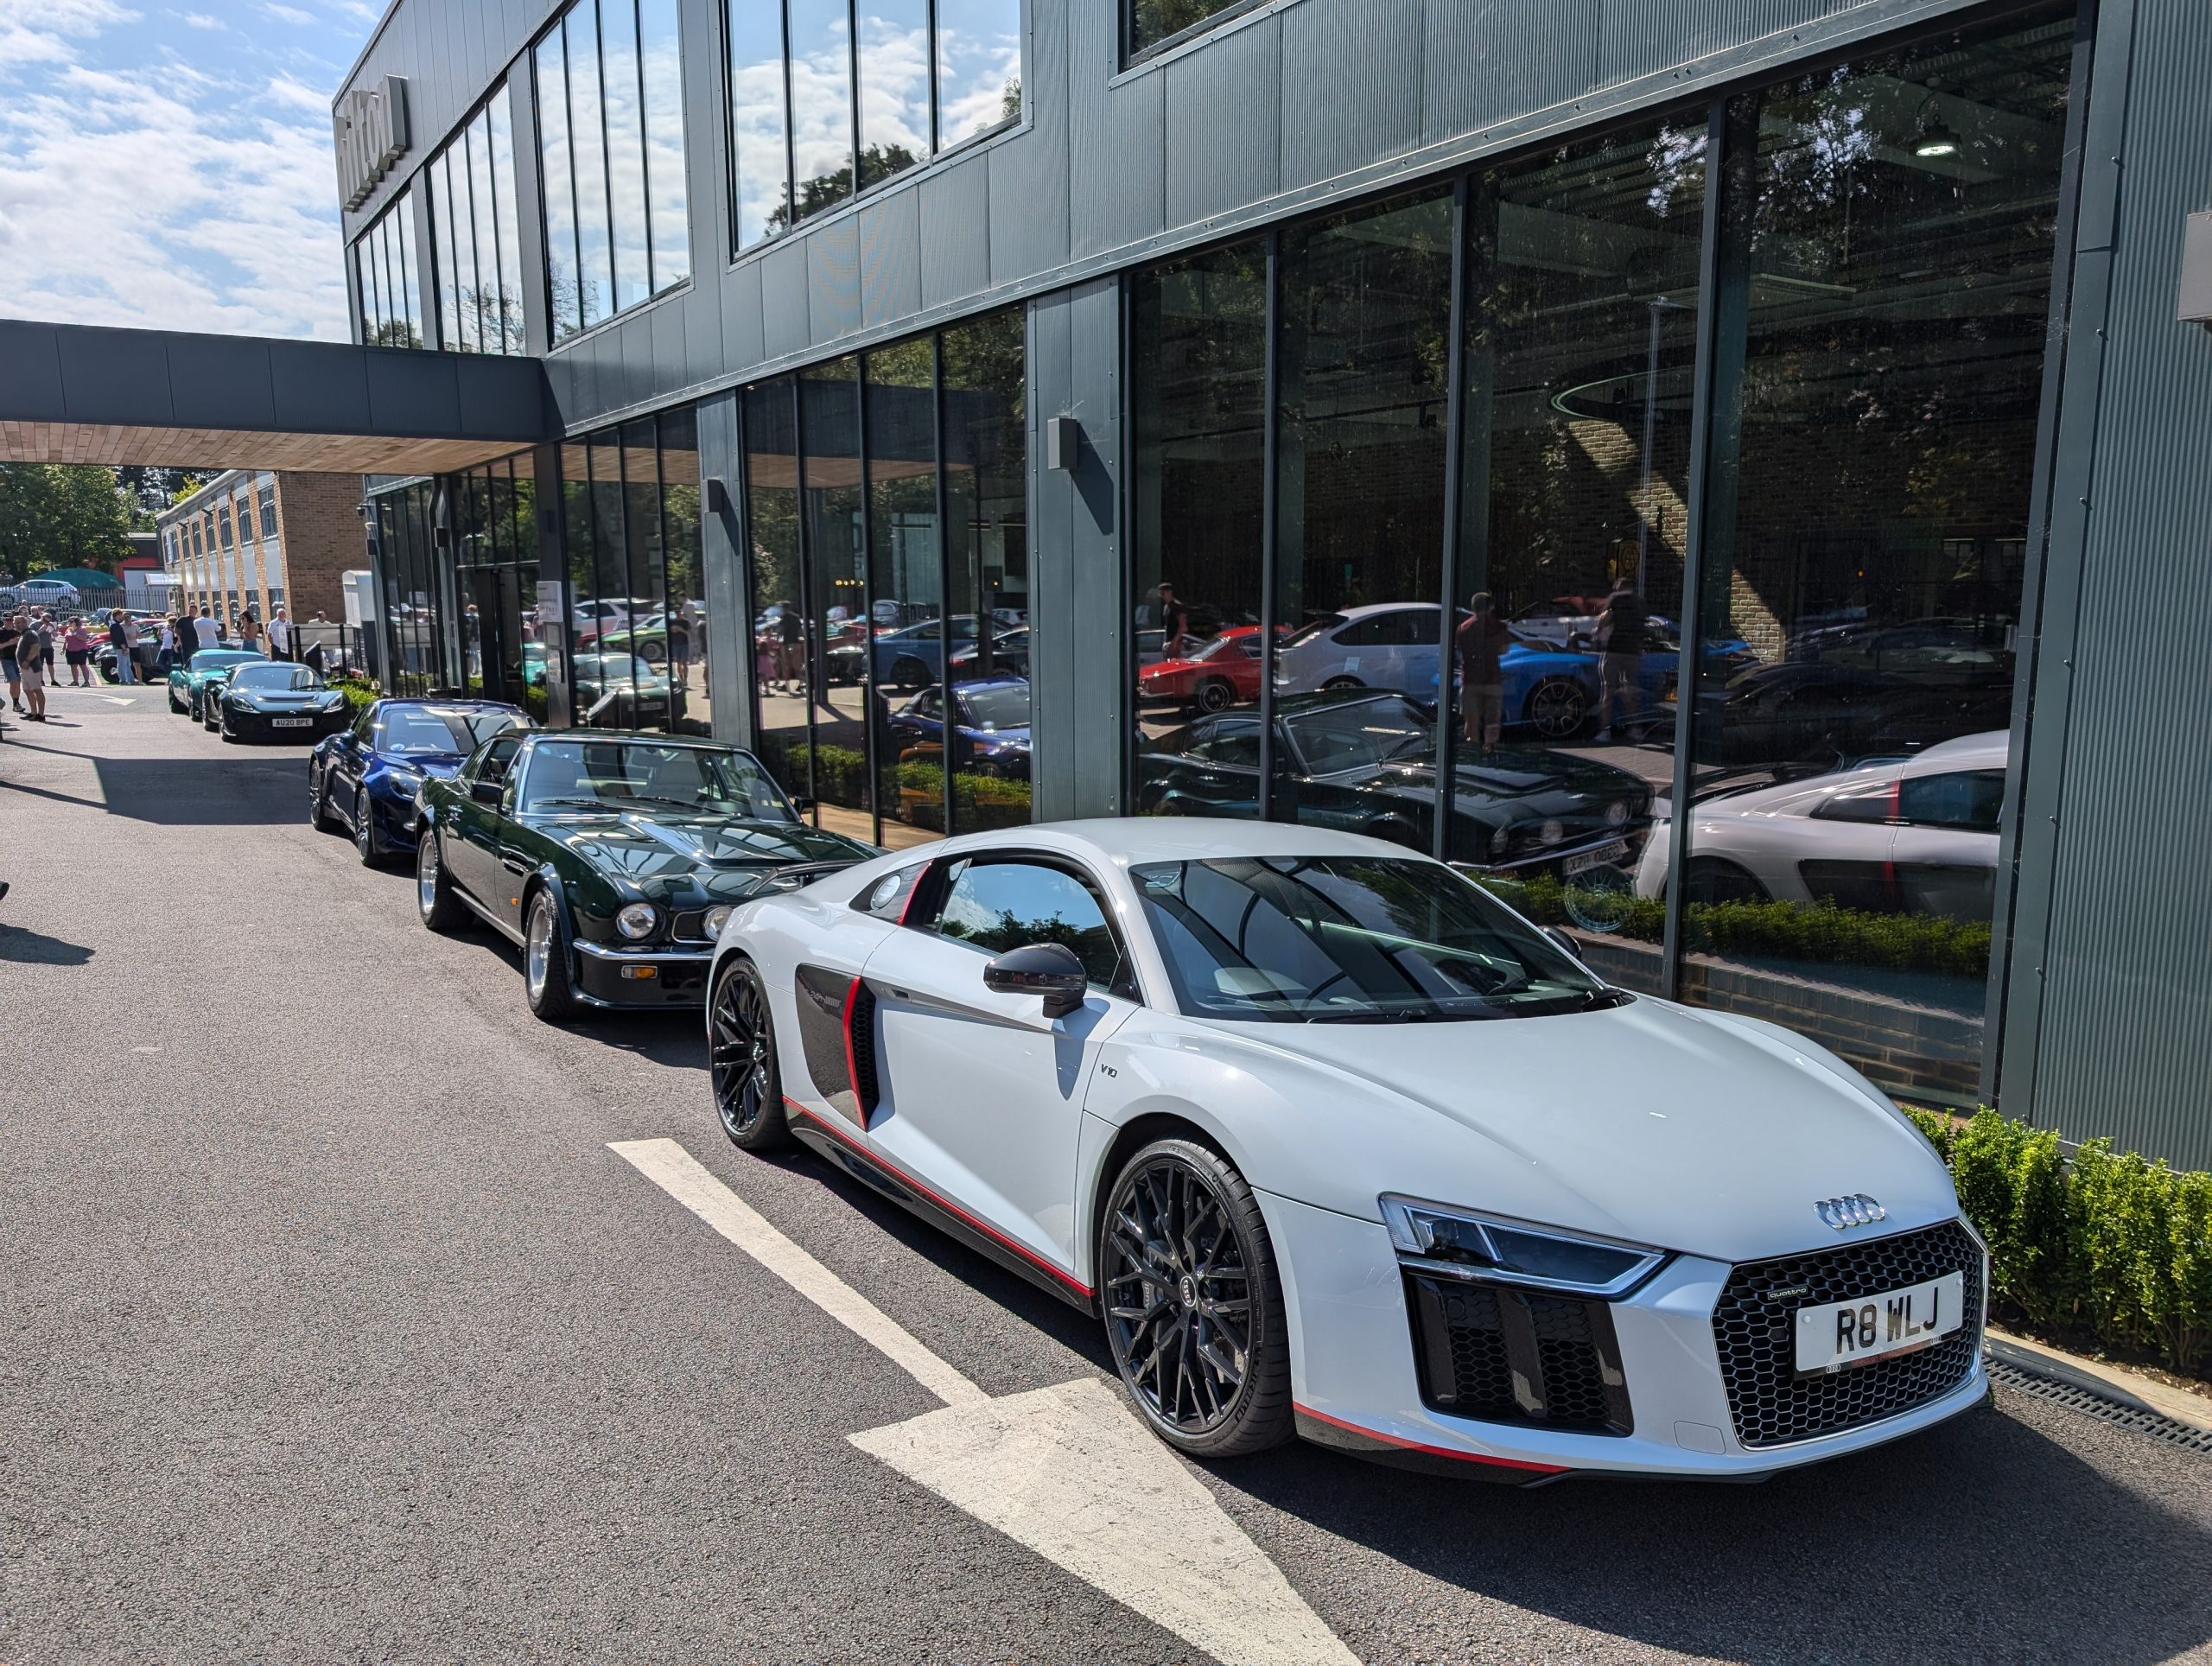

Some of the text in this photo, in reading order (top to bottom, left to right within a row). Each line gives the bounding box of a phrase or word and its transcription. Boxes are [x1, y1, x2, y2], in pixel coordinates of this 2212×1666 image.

[1101, 1063, 1118, 1078] V10
[1770, 1288, 1807, 1299] quattro
[1836, 1304, 1878, 1354] R8
[1887, 1287, 1939, 1343] WLJ
